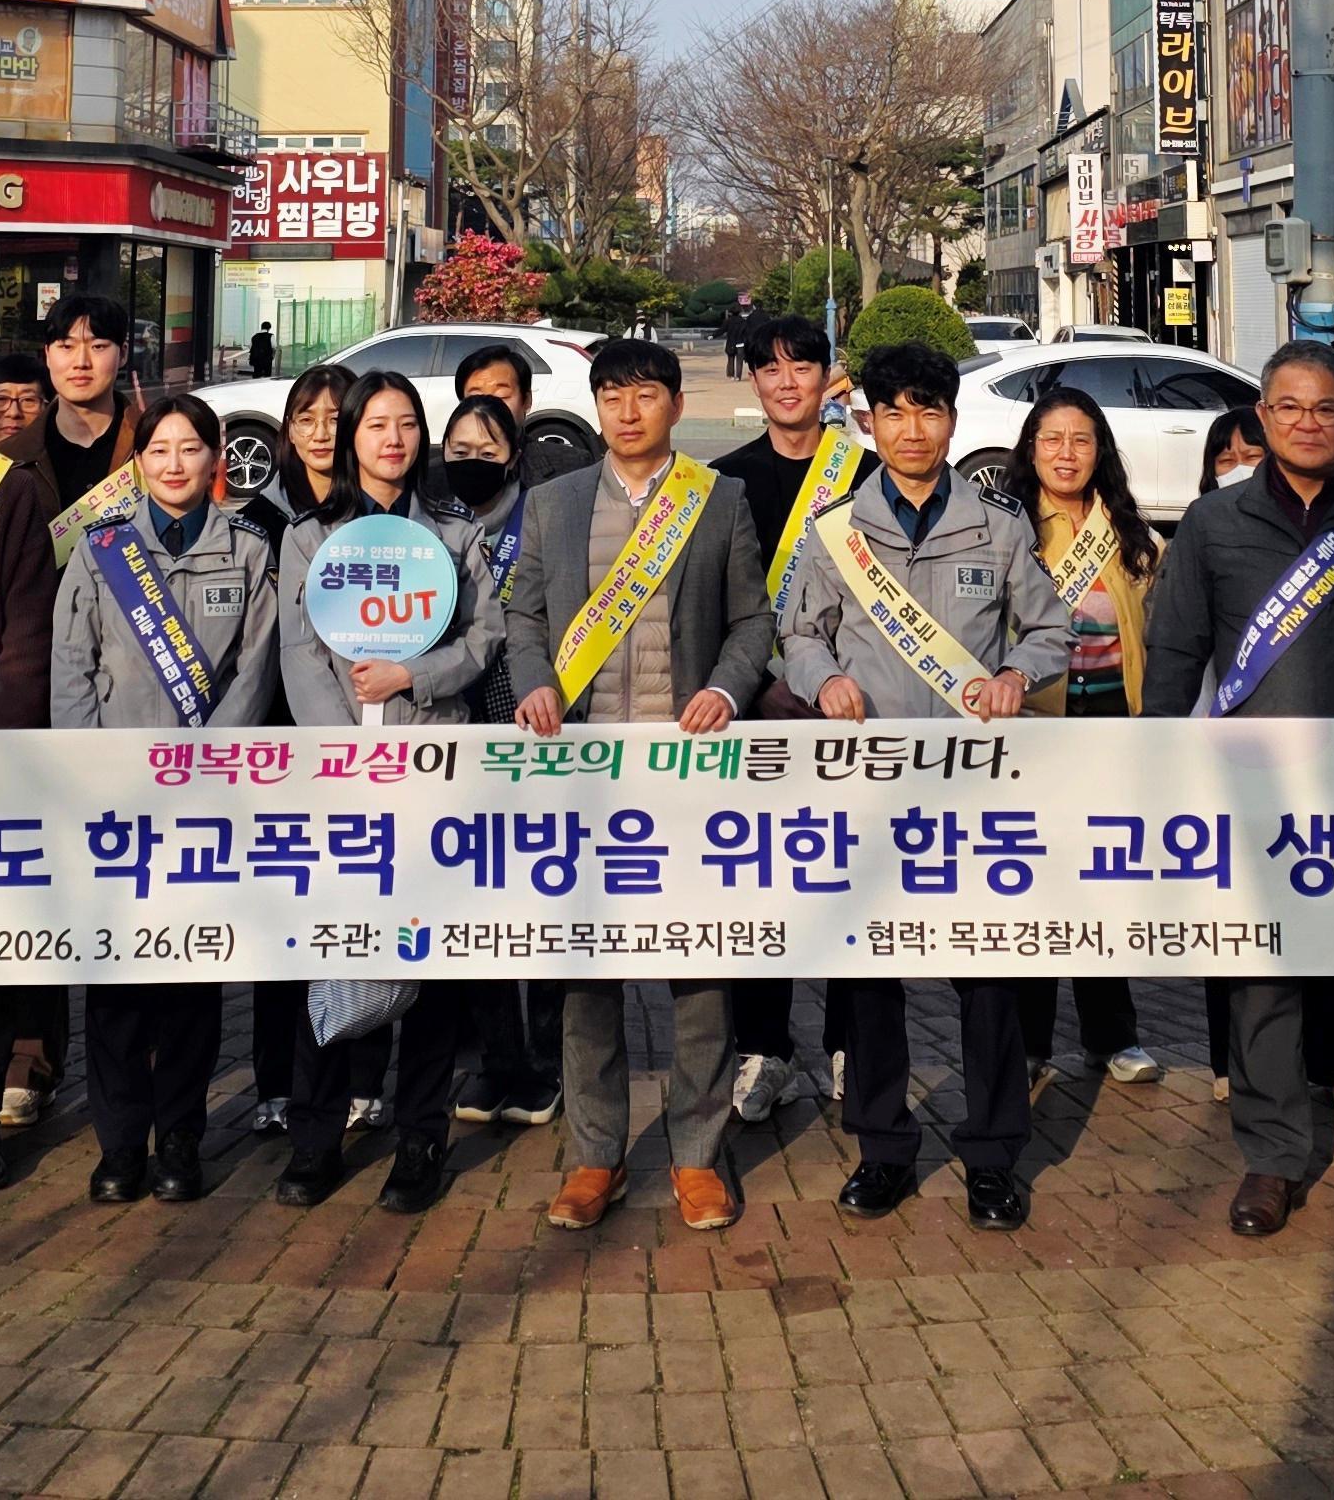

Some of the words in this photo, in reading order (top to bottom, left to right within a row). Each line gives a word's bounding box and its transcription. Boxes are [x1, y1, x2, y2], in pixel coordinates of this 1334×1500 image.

[1159, 11, 1193, 29] 틱톡
[1160, 32, 1195, 133] 라이브
[278, 159, 379, 195] 사우나
[1077, 159, 1094, 205] 라이브
[231, 219, 269, 238] 24시
[277, 202, 379, 238] 찜질방
[1075, 210, 1099, 250] 사랑
[638, 495, 677, 551] 행복한
[678, 489, 700, 526] 작은
[643, 526, 685, 579] 관심과
[319, 562, 400, 591] 성폭력
[598, 553, 640, 611] 교실을
[845, 531, 901, 602] 담배연기
[898, 601, 938, 643] 없는
[959, 568, 994, 584] 경찰
[960, 586, 993, 597] POLICE
[207, 605, 242, 615] POLICE
[360, 590, 437, 627] OUT
[608, 580, 650, 635] 배려가
[869, 599, 920, 658] 행복한
[917, 651, 959, 694] 학교
[147, 740, 294, 785] 행복한
[312, 740, 458, 782] 교실이
[480, 739, 624, 781] 목포의
[648, 737, 791, 781] 미래를
[814, 736, 1022, 781] 만듭니다.
[84, 810, 397, 899] 학교폭력
[430, 808, 670, 897] 예방을
[701, 806, 860, 893] 위한
[890, 806, 1048, 897] 합동
[1079, 814, 1232, 890] 교외
[93, 928, 121, 962] 3.
[134, 924, 236, 963] 26.(목)
[309, 923, 382, 960] 주관:
[440, 920, 788, 958] 전라남도목포교육지원청
[866, 921, 936, 957] 협력:
[948, 921, 1114, 959] 목포경찰서,
[1126, 922, 1283, 958] 하당지구대
